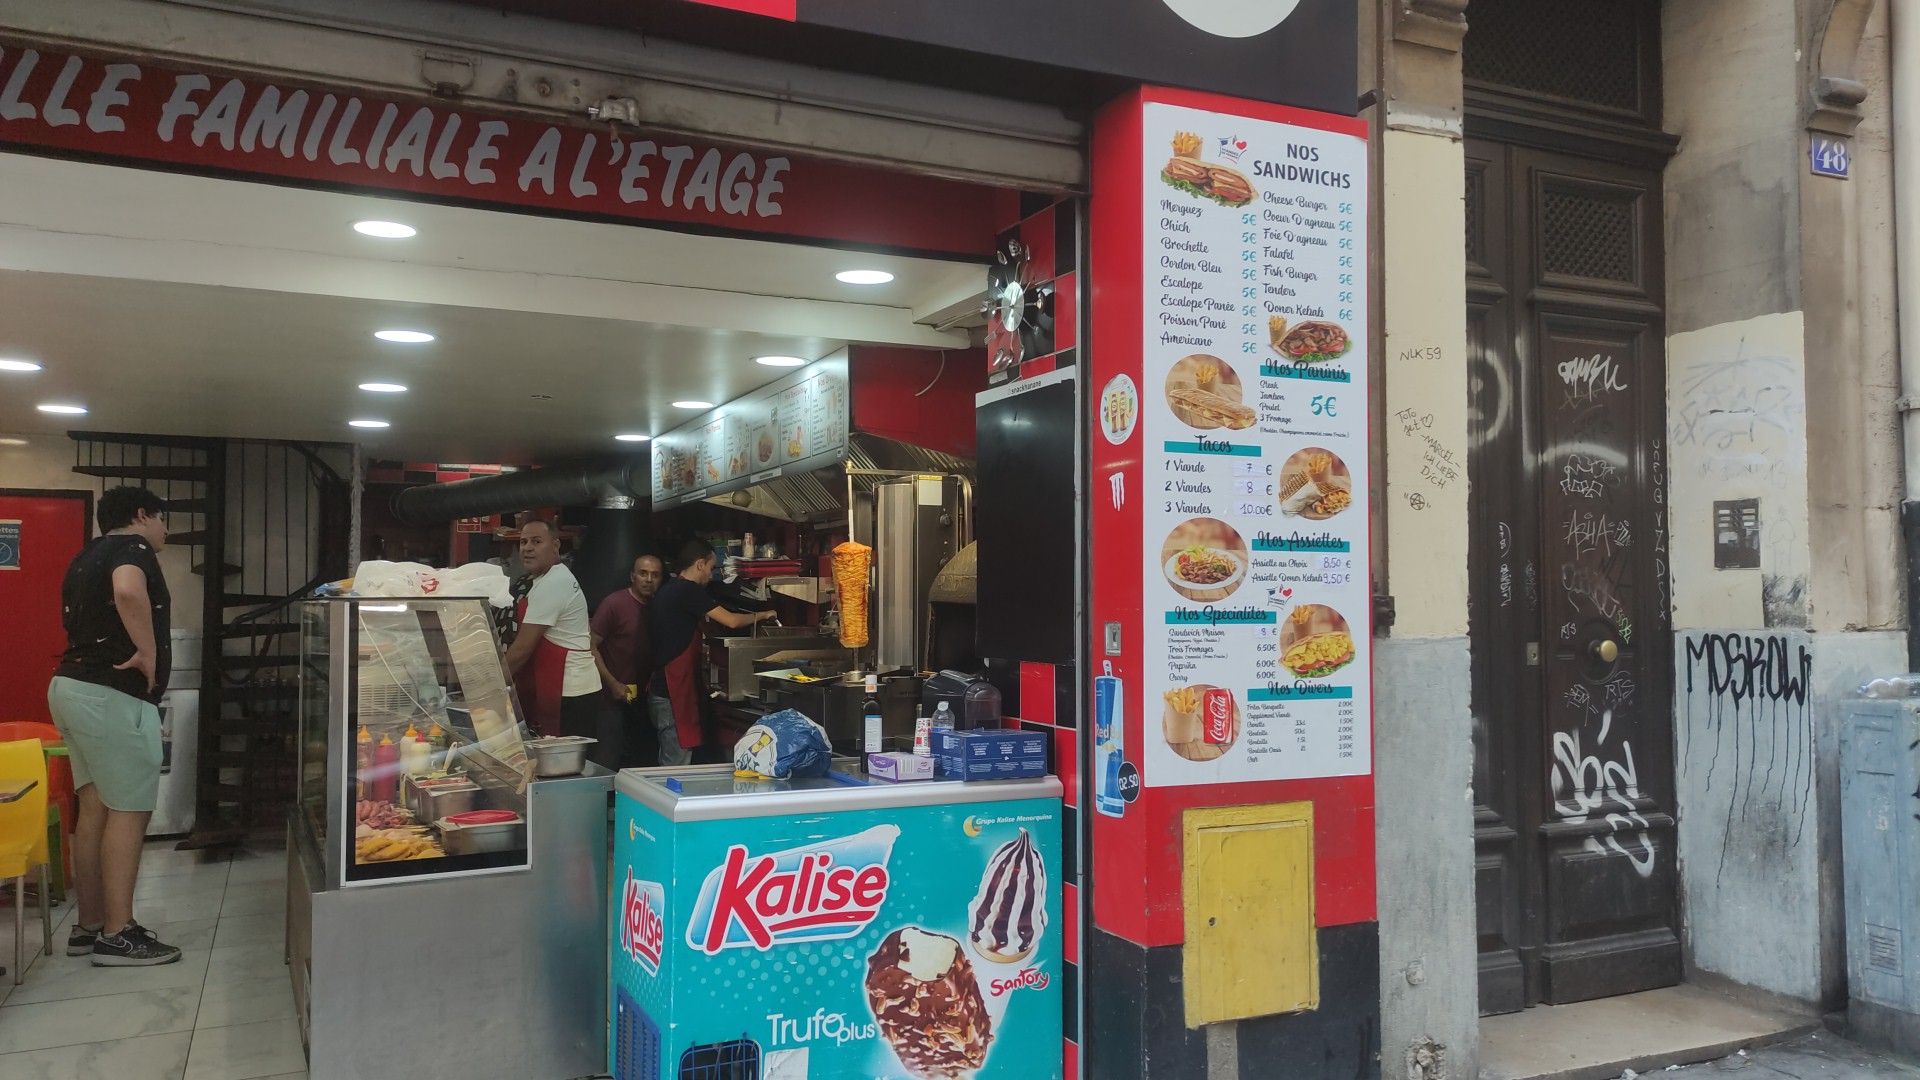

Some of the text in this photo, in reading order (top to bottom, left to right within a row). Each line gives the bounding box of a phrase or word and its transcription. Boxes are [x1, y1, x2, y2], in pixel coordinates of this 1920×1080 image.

[0, 46, 791, 218] LLE FAMILIALE A L'ETAGE
[1287, 143, 1319, 162] NOS
[1816, 140, 1846, 171] 48
[1253, 160, 1351, 189] SANDWICHS
[1160, 199, 1203, 217] Merguez
[1263, 190, 1328, 211] Cheese Burger
[1339, 202, 1353, 215] 5€
[1160, 217, 1191, 234] Chich
[1242, 213, 1257, 226] 5€
[1263, 209, 1336, 230] Coeur D'agneau
[1339, 220, 1353, 233] 5€
[1160, 236, 1209, 254] Brochette
[1242, 232, 1257, 245] 5€
[1263, 227, 1328, 247] Foie D'agneau
[1339, 238, 1353, 250] 5€
[1242, 250, 1257, 263] 5€
[1262, 246, 1295, 261] Falafel
[1160, 255, 1223, 274] Cordon Bleu
[1339, 256, 1353, 268] 5€
[1242, 268, 1257, 281] 5€
[1263, 264, 1318, 282] Fish Burger
[1339, 273, 1353, 285] 5€
[1160, 274, 1204, 294] Escalope
[1262, 282, 1296, 297] Tenders
[1242, 287, 1257, 300] 5€
[1339, 291, 1353, 303] 5€
[1160, 293, 1236, 313] Escalope Panée
[1263, 300, 1325, 318] Doner Kebab
[1242, 305, 1257, 318] 5€
[1339, 309, 1353, 321] 6€
[1159, 312, 1228, 330] Poisson Pané
[1242, 323, 1257, 336] 5€
[1160, 330, 1213, 347] Americano
[1242, 342, 1257, 354] 5€
[1400, 346, 1442, 362] NLK 59
[1265, 358, 1348, 381] Nos Paninis
[1259, 402, 1281, 412] Poulet
[1311, 395, 1337, 417] 5€
[1260, 413, 1265, 421] 3
[1194, 434, 1233, 454] Tacos
[1165, 457, 1206, 473] 1 Viande
[1246, 462, 1273, 475] 7 €
[1435, 459, 1460, 482] LIEBE
[1164, 478, 1212, 494] 2 Viandes
[1246, 481, 1273, 496] 8 €
[1164, 499, 1212, 515] 3 Viandes
[1257, 530, 1344, 552] Nos Assiettes
[1251, 558, 1277, 569] Assiette
[1288, 558, 1308, 569] Choix
[1345, 560, 1351, 568] €
[1251, 573, 1323, 583] Assiette Doner Kebab
[1345, 574, 1351, 583] €
[1174, 604, 1267, 626] Nos Spécialités
[1169, 627, 1200, 637] Sandwich
[1272, 628, 1277, 636] €
[1168, 645, 1184, 653] Trois
[1168, 661, 1197, 672] Paprika
[1686, 632, 1811, 706] MOSKOW
[1168, 672, 1188, 682] Curry
[1267, 679, 1333, 696] Nos Divers
[976, 817, 996, 826] Grupo
[997, 816, 1015, 824] Kalise
[706, 847, 887, 952] Kalise
[623, 867, 664, 960] Kalise
[766, 1007, 876, 1047] Trufo plus
